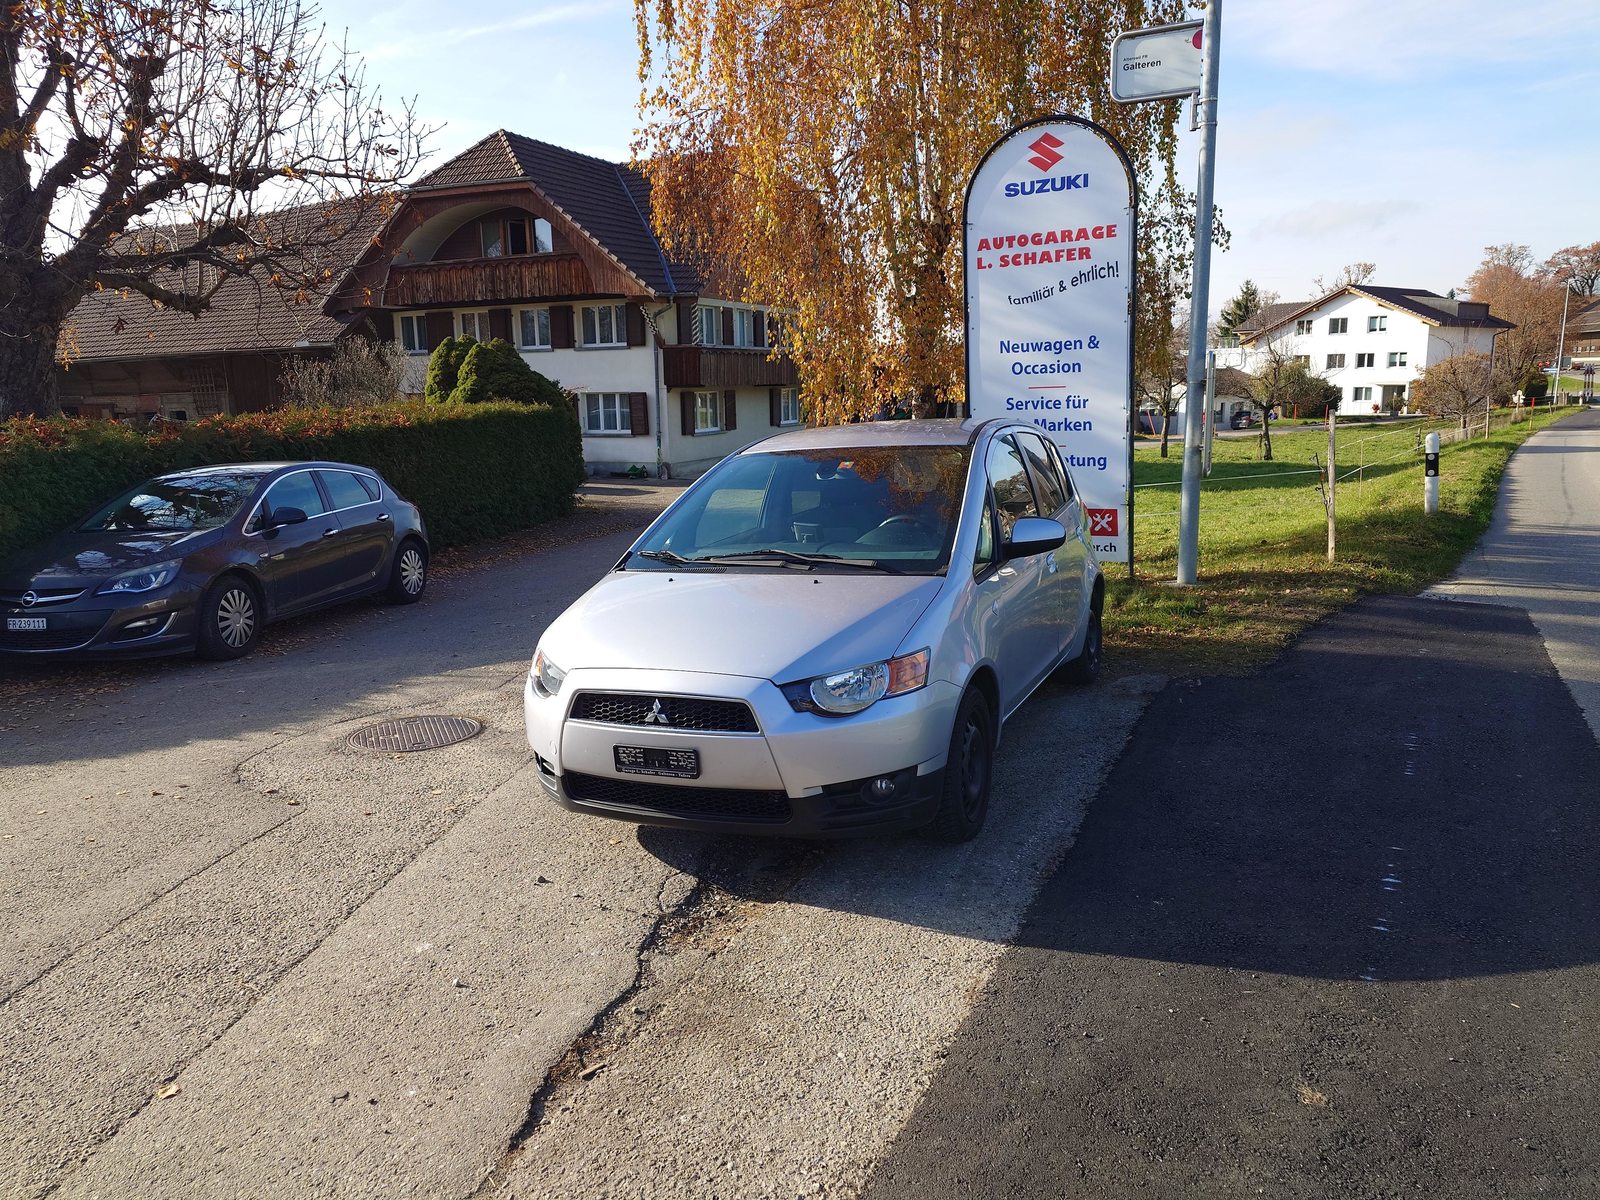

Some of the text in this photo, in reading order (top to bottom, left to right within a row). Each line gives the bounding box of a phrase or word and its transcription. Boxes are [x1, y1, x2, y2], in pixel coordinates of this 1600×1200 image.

[1123, 60, 1161, 71] Galteren
[1005, 173, 1089, 197] SUZUKI
[977, 224, 1117, 251] AUTOGARAGE
[977, 257, 993, 270] L.
[1008, 261, 1119, 305] familiär & ehrlich!
[1000, 335, 1100, 354] Neuwagen &
[1011, 360, 1082, 375] Occasion
[1006, 395, 1089, 411] Service für
[1033, 417, 1092, 432] Marken
